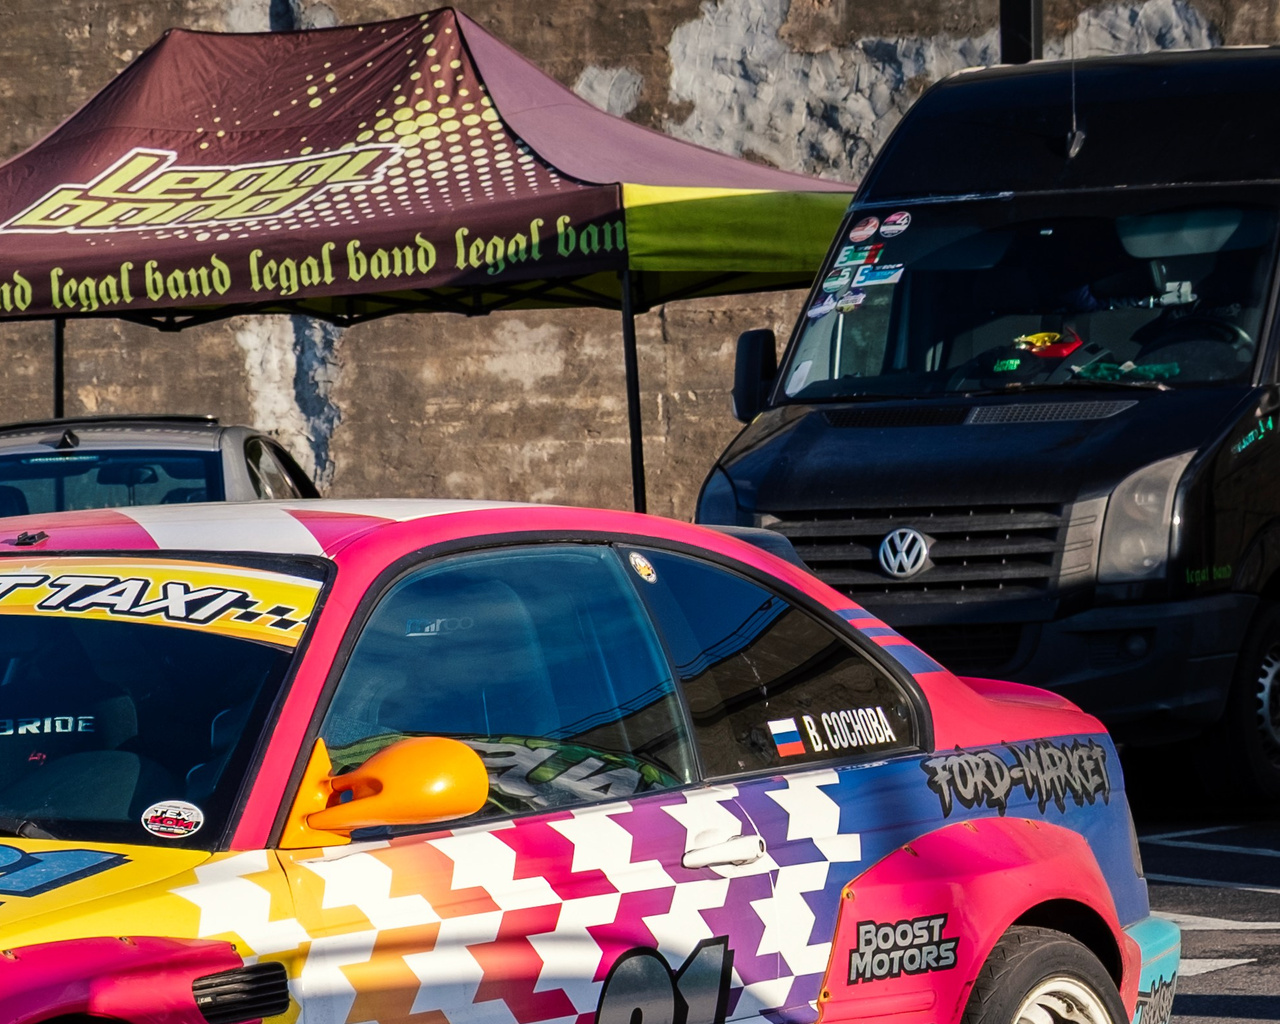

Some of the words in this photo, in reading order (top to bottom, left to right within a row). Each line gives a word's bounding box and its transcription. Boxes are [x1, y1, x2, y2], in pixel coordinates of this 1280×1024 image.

[50, 262, 133, 312] legal
[145, 254, 231, 301] band
[249, 241, 335, 295] legal
[347, 232, 436, 282] band
[455, 218, 543, 275] legal
[556, 215, 624, 257] ban
[38, 576, 249, 624] TAXI
[922, 740, 1111, 817] FORD-MARKET
[858, 917, 946, 951] BOOST
[850, 942, 956, 981] MOTORS
